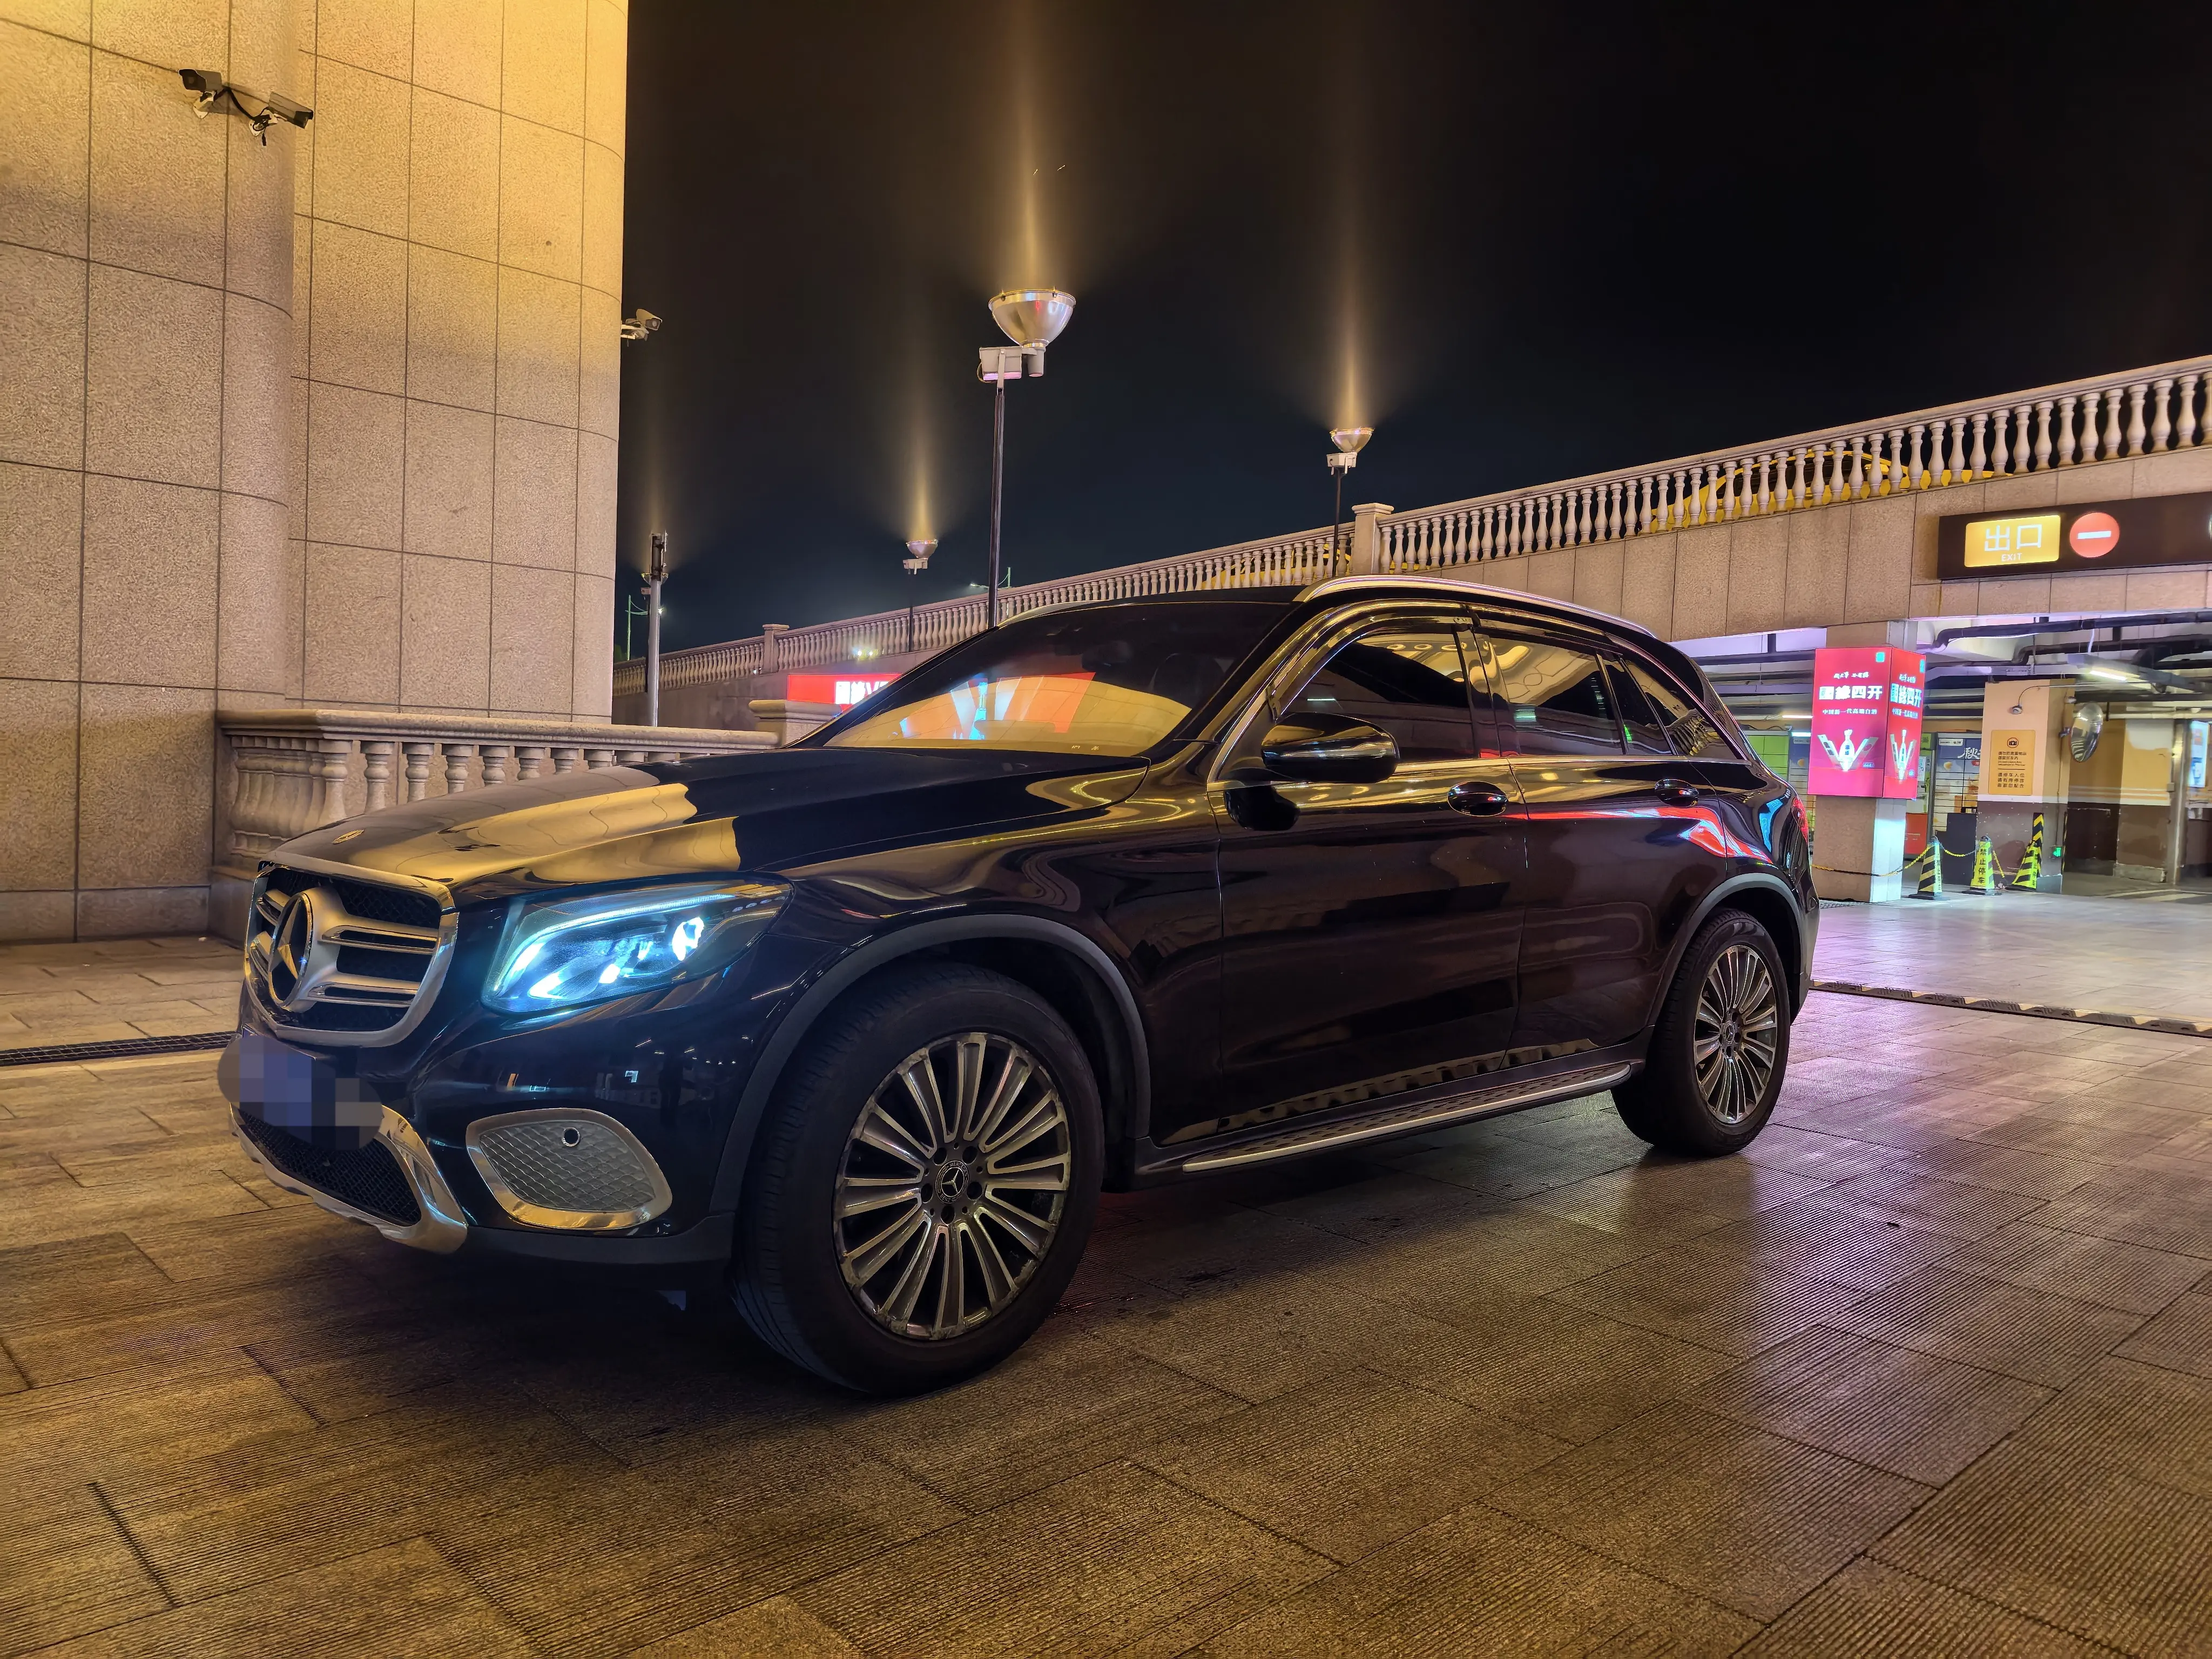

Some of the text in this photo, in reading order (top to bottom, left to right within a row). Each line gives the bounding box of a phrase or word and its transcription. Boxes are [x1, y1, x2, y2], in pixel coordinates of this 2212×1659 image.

[1984, 524, 2042, 551] 出口
[2001, 553, 2022, 562] EXIT
[1958, 747, 1981, 759] 秋
[1978, 848, 1988, 884] 禁止停车
